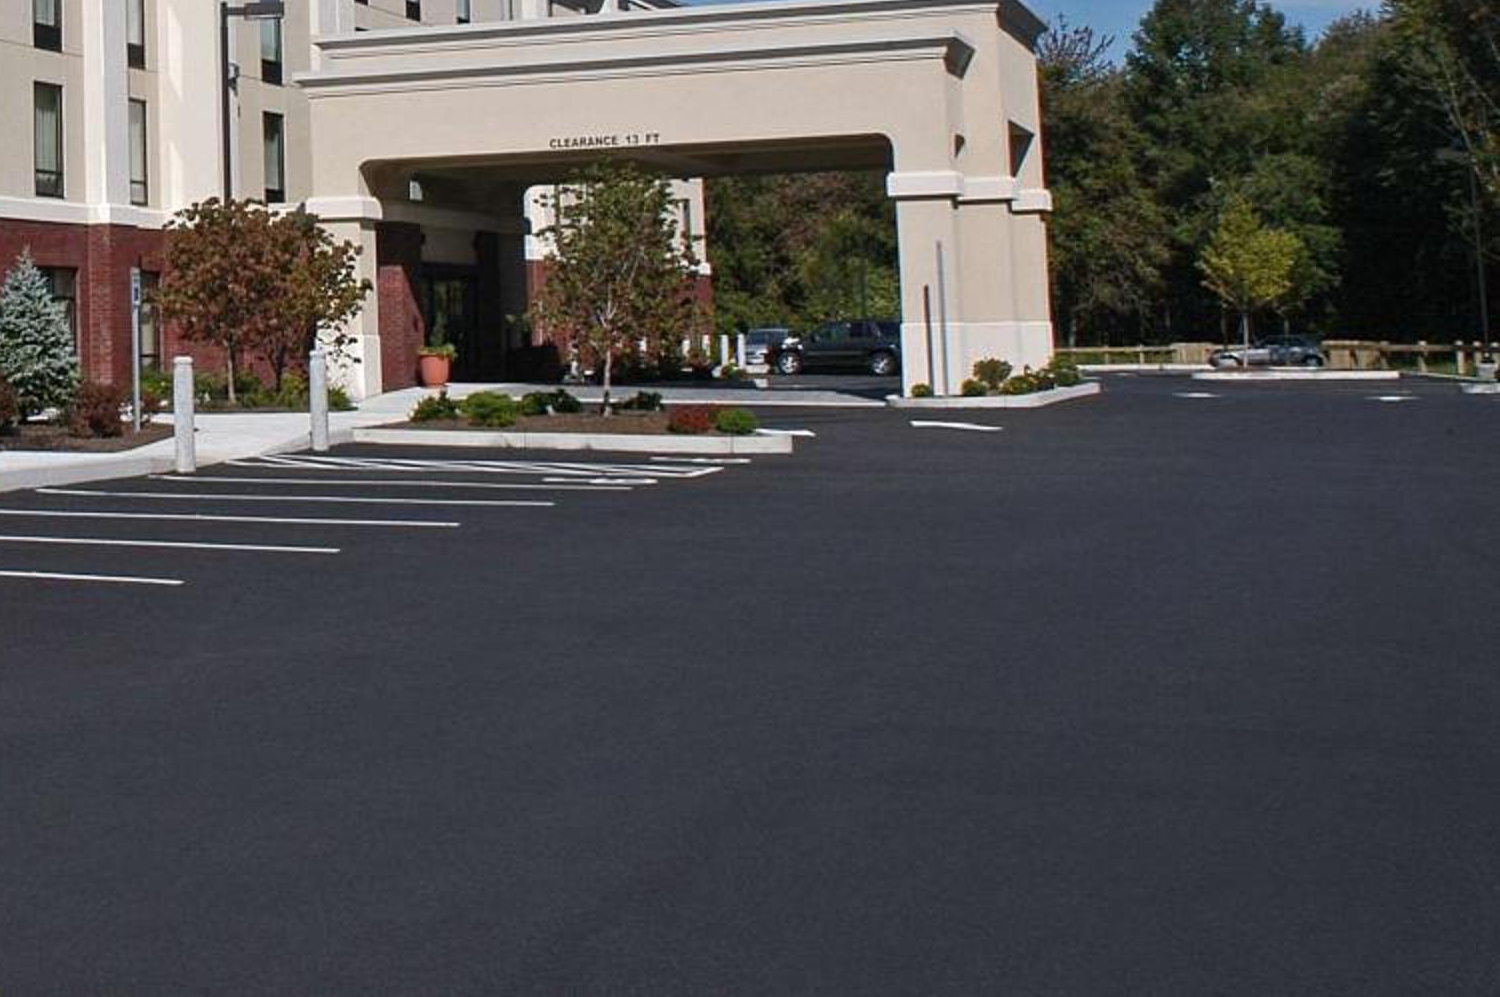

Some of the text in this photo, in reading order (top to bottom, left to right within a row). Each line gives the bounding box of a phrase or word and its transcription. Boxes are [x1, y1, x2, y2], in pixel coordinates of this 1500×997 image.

[549, 133, 660, 148] CLEARANCE 13 FT
